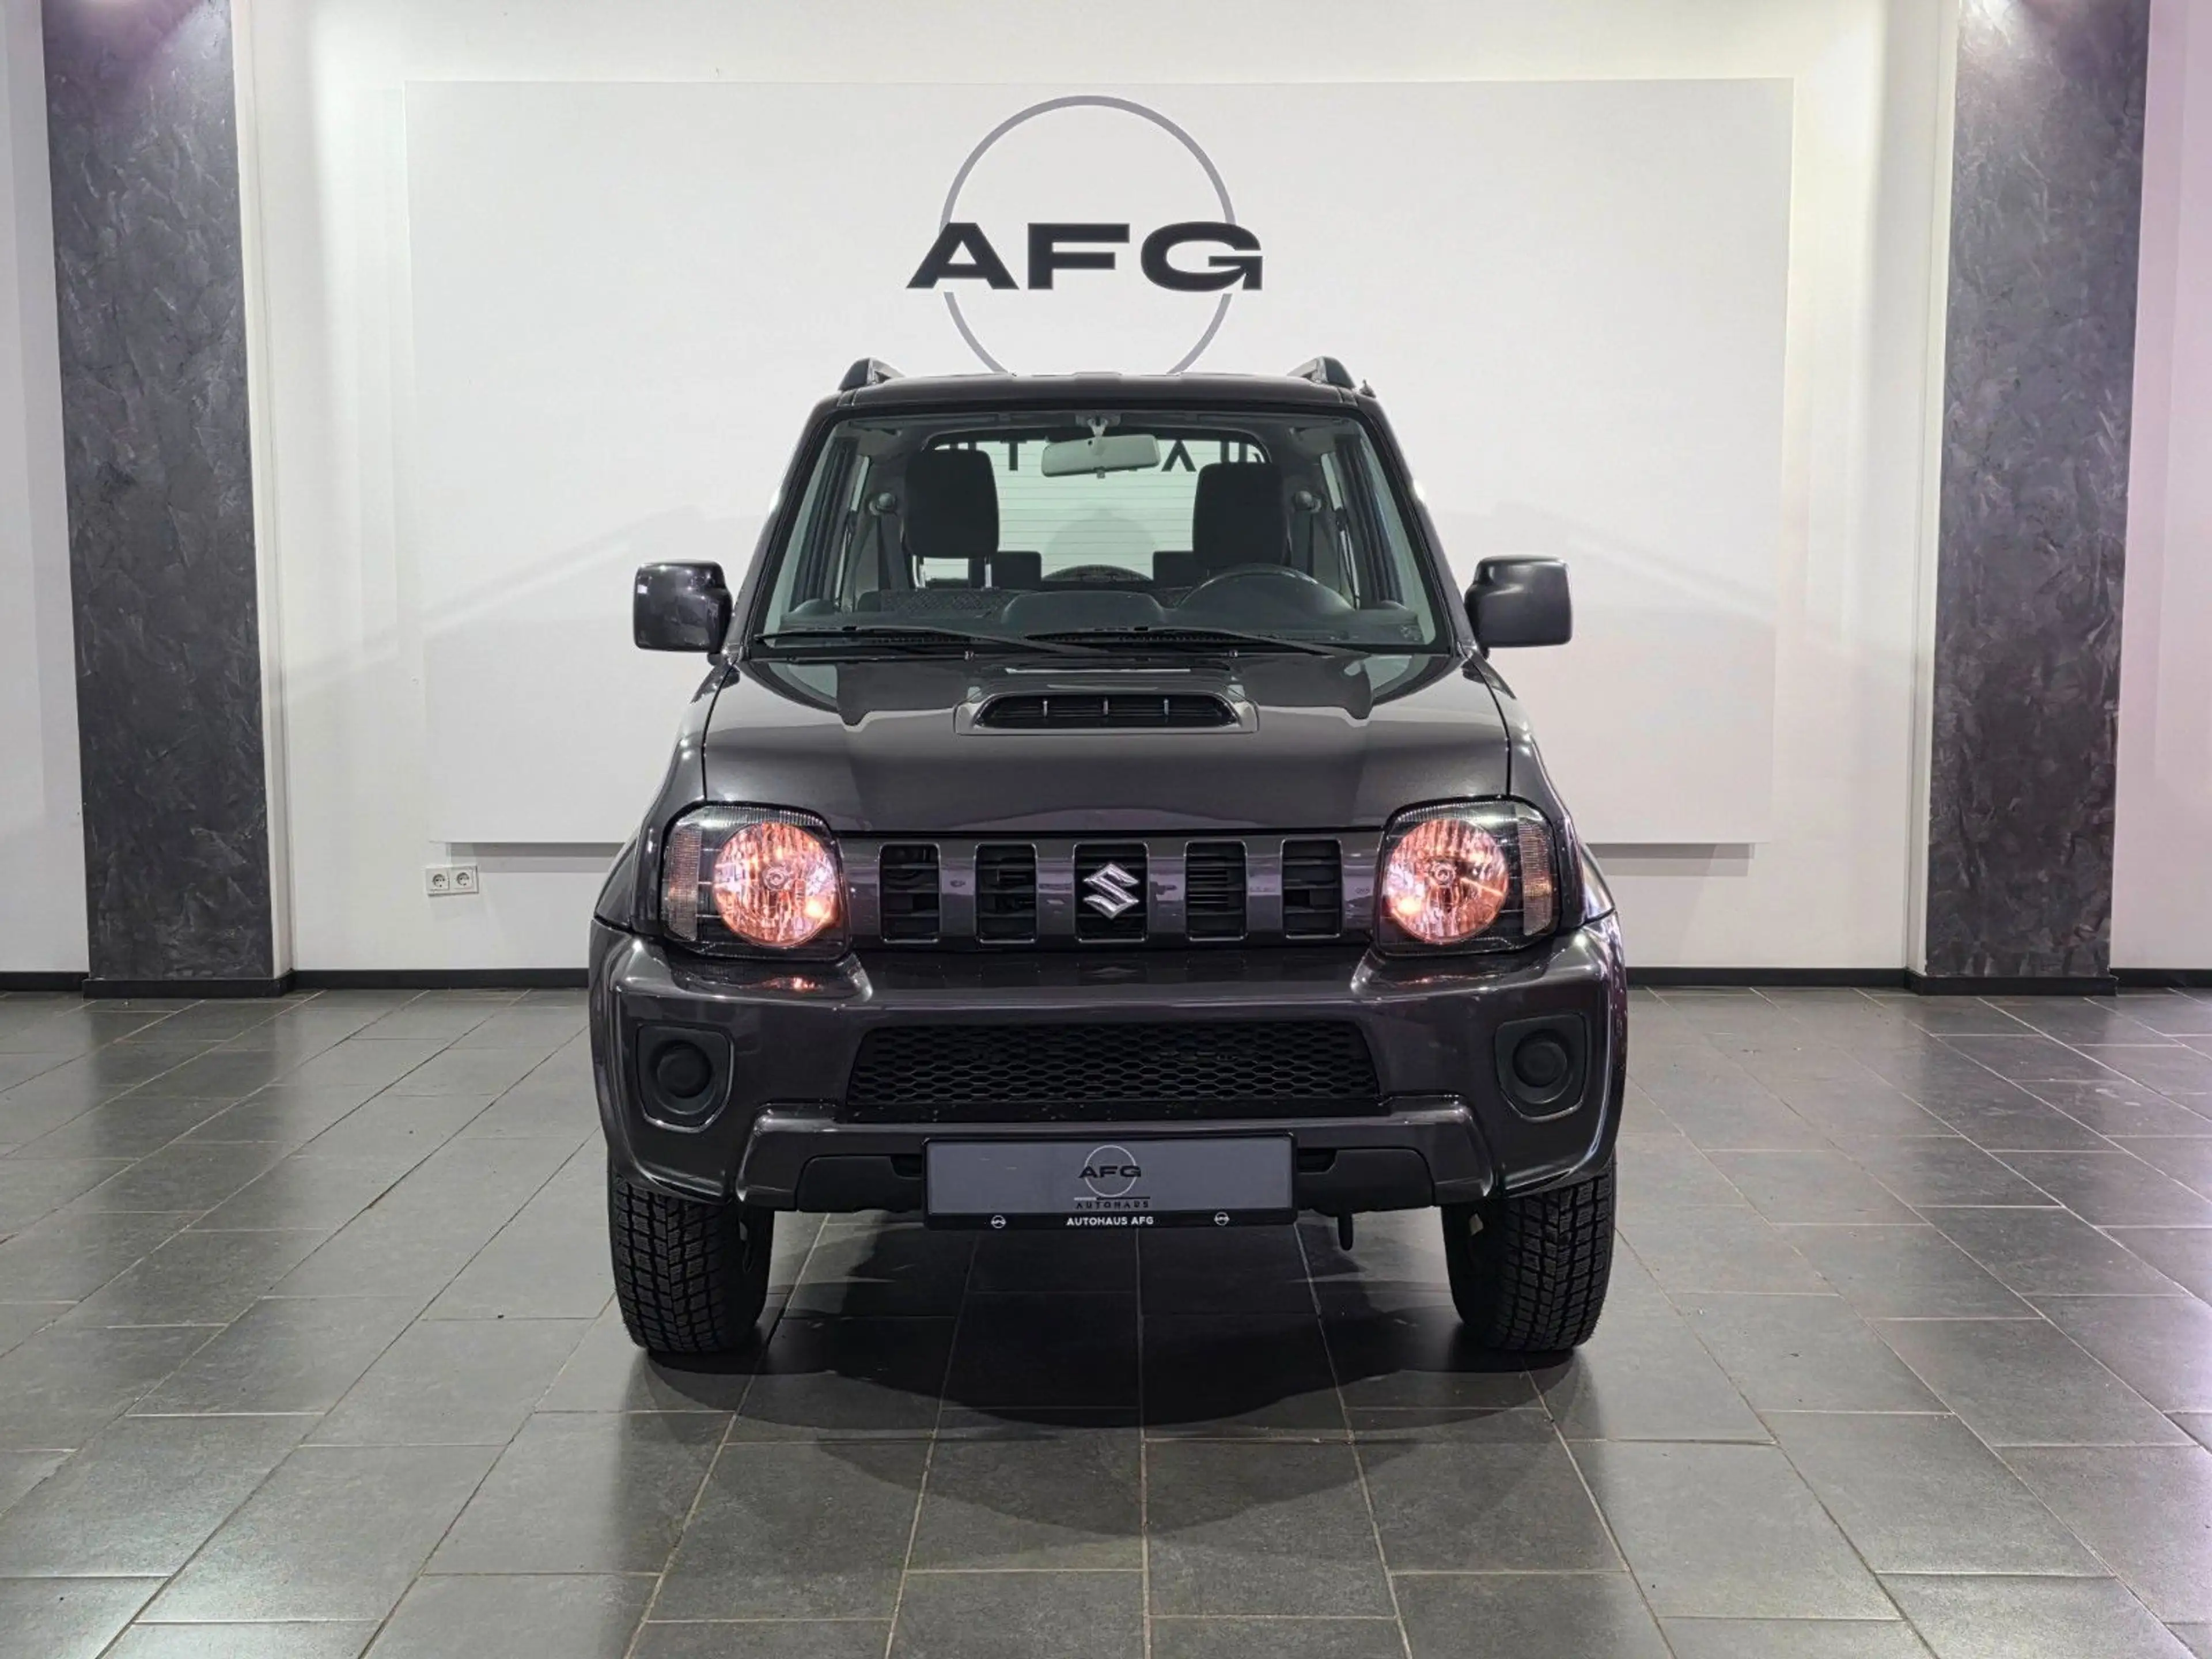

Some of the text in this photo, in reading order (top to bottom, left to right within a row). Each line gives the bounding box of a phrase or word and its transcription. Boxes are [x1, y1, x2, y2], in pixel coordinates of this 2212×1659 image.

[906, 221, 1263, 292] AFG
[1078, 1165, 1141, 1178] AFG
[1075, 1200, 1149, 1209] AUTOHAUS
[1066, 1216, 1154, 1226] AUTOHAUS AFG
